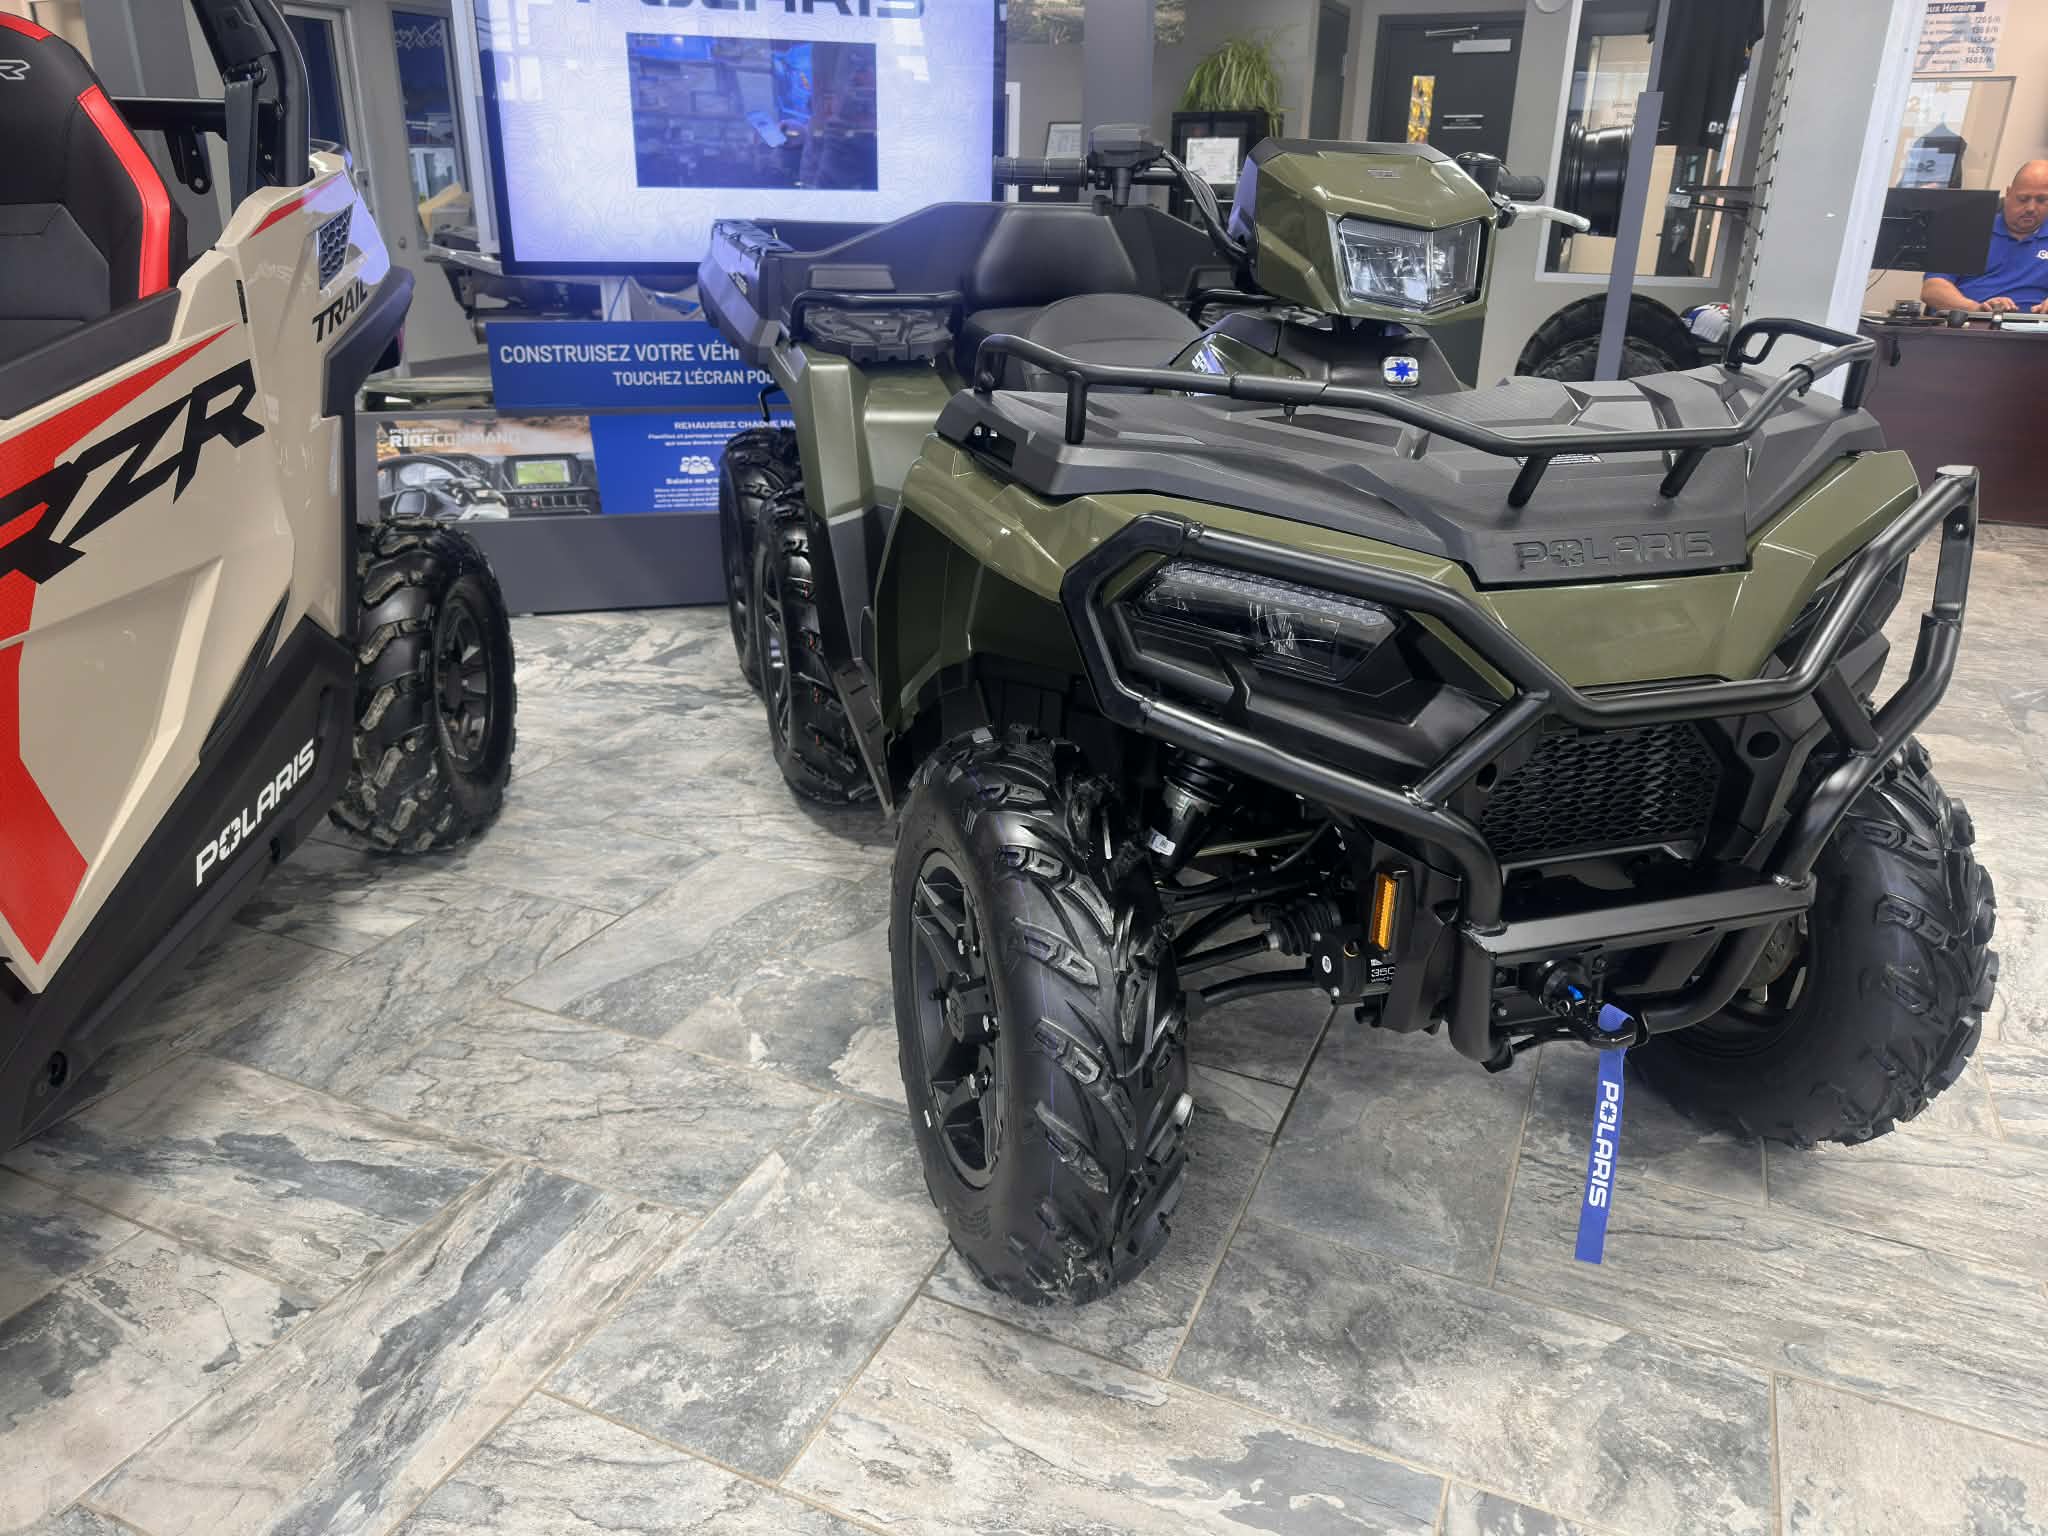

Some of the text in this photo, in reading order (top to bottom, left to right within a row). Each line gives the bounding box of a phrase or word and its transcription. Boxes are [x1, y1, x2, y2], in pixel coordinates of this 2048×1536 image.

[312, 280, 368, 344] TRAIL
[500, 344, 631, 363] CONSTRUISEZ
[634, 344, 694, 362] VOTRE
[613, 371, 682, 386] TOUCHEZ
[685, 369, 744, 385] L'ÉCRAN
[674, 421, 736, 430] REHAUSSEZ
[1513, 530, 1714, 571] POLARIS
[195, 737, 315, 887] POLARIS
[1588, 1080, 1620, 1209] POLARIS
